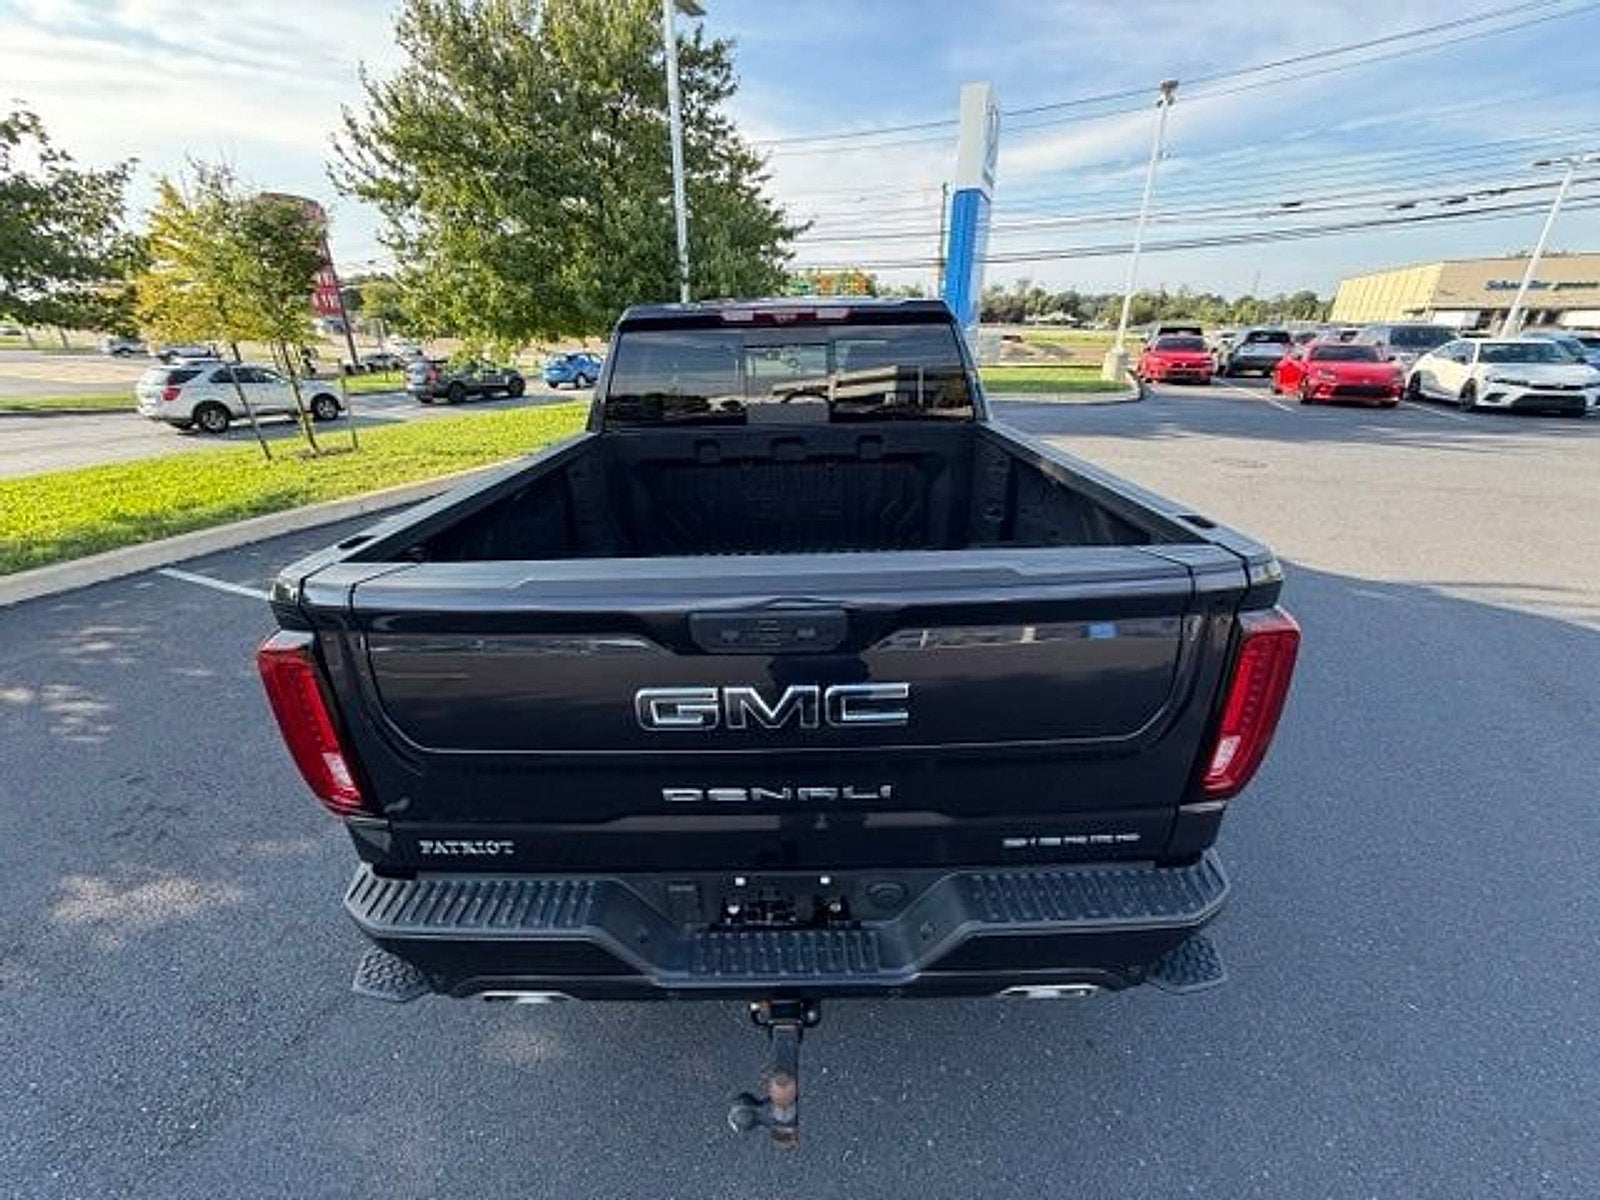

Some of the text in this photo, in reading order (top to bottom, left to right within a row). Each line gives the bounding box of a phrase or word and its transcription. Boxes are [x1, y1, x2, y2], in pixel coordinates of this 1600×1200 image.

[635, 682, 909, 731] GMC
[662, 785, 892, 801] DENALI
[419, 840, 514, 855] PATRIOT
